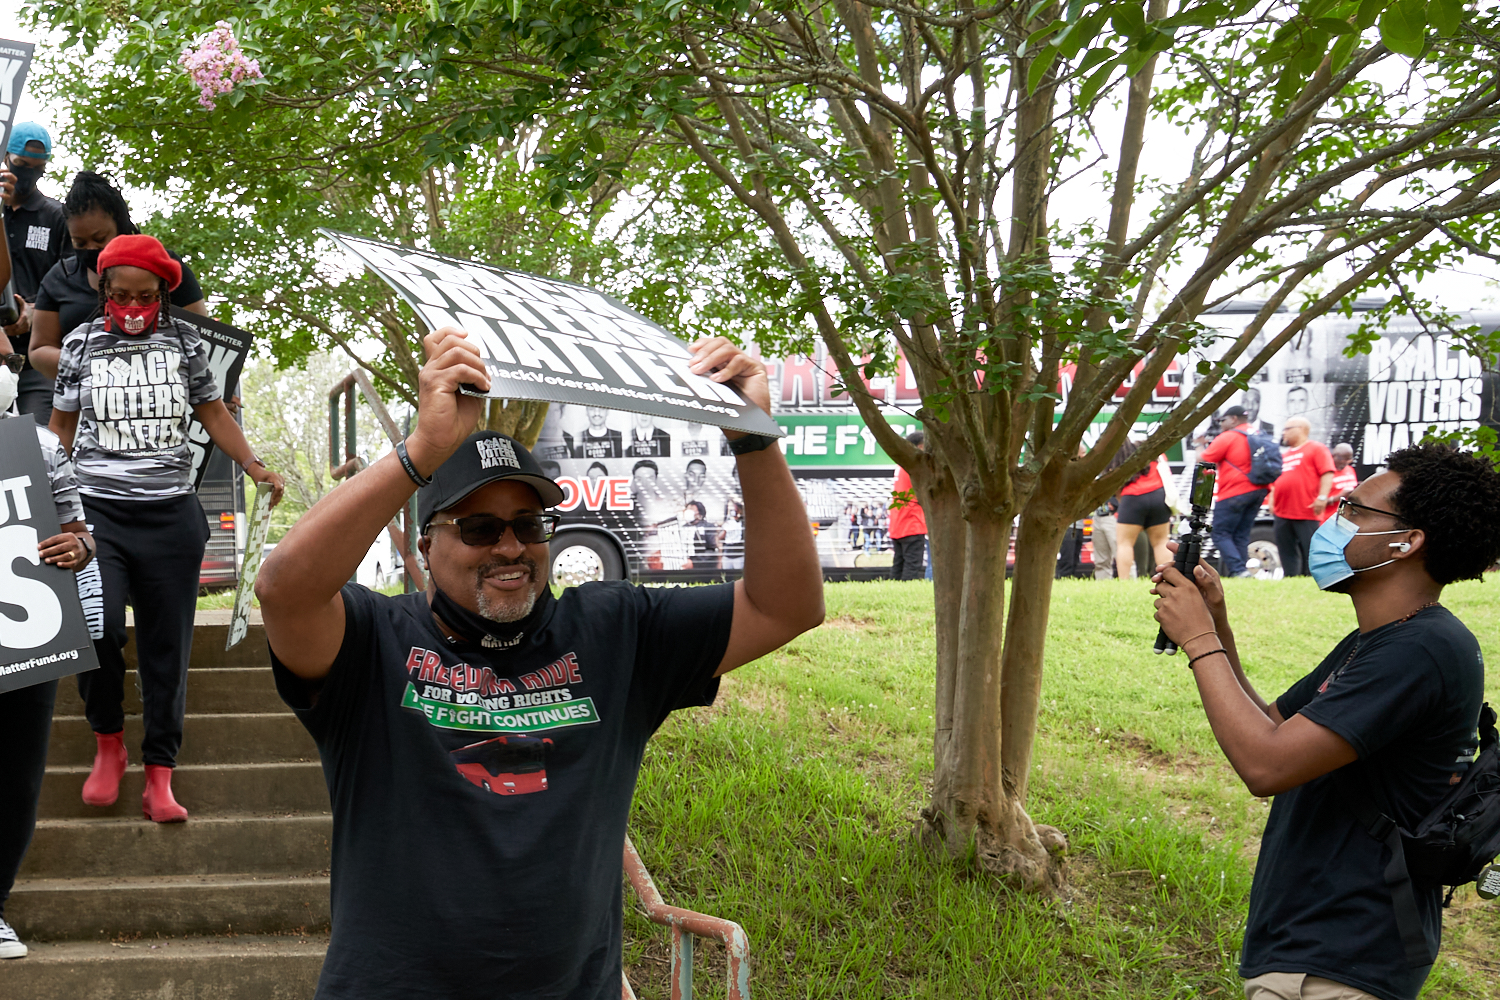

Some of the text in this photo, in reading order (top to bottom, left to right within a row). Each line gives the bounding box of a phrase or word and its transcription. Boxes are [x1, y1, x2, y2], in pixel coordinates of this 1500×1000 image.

[28, 225, 51, 236] BACK
[25, 240, 49, 251] MATTER
[376, 266, 692, 360] VOTERS
[200, 326, 244, 348] WE MATTER.
[90, 350, 183, 388] BACK
[91, 383, 186, 421] VOTERS
[486, 364, 741, 418] BlackVotersMatterFund.org
[1368, 378, 1484, 424] VOTERS
[96, 417, 183, 451] MATTER
[475, 437, 514, 451] BACK
[478, 448, 518, 460] VOTERS
[480, 457, 522, 470] MATTER
[546, 476, 635, 512] OVE
[406, 646, 583, 697] FREEDOM RIDE
[422, 685, 452, 699] FOR
[513, 688, 573, 708] RIGHTS
[493, 703, 591, 728] CONTINUES
